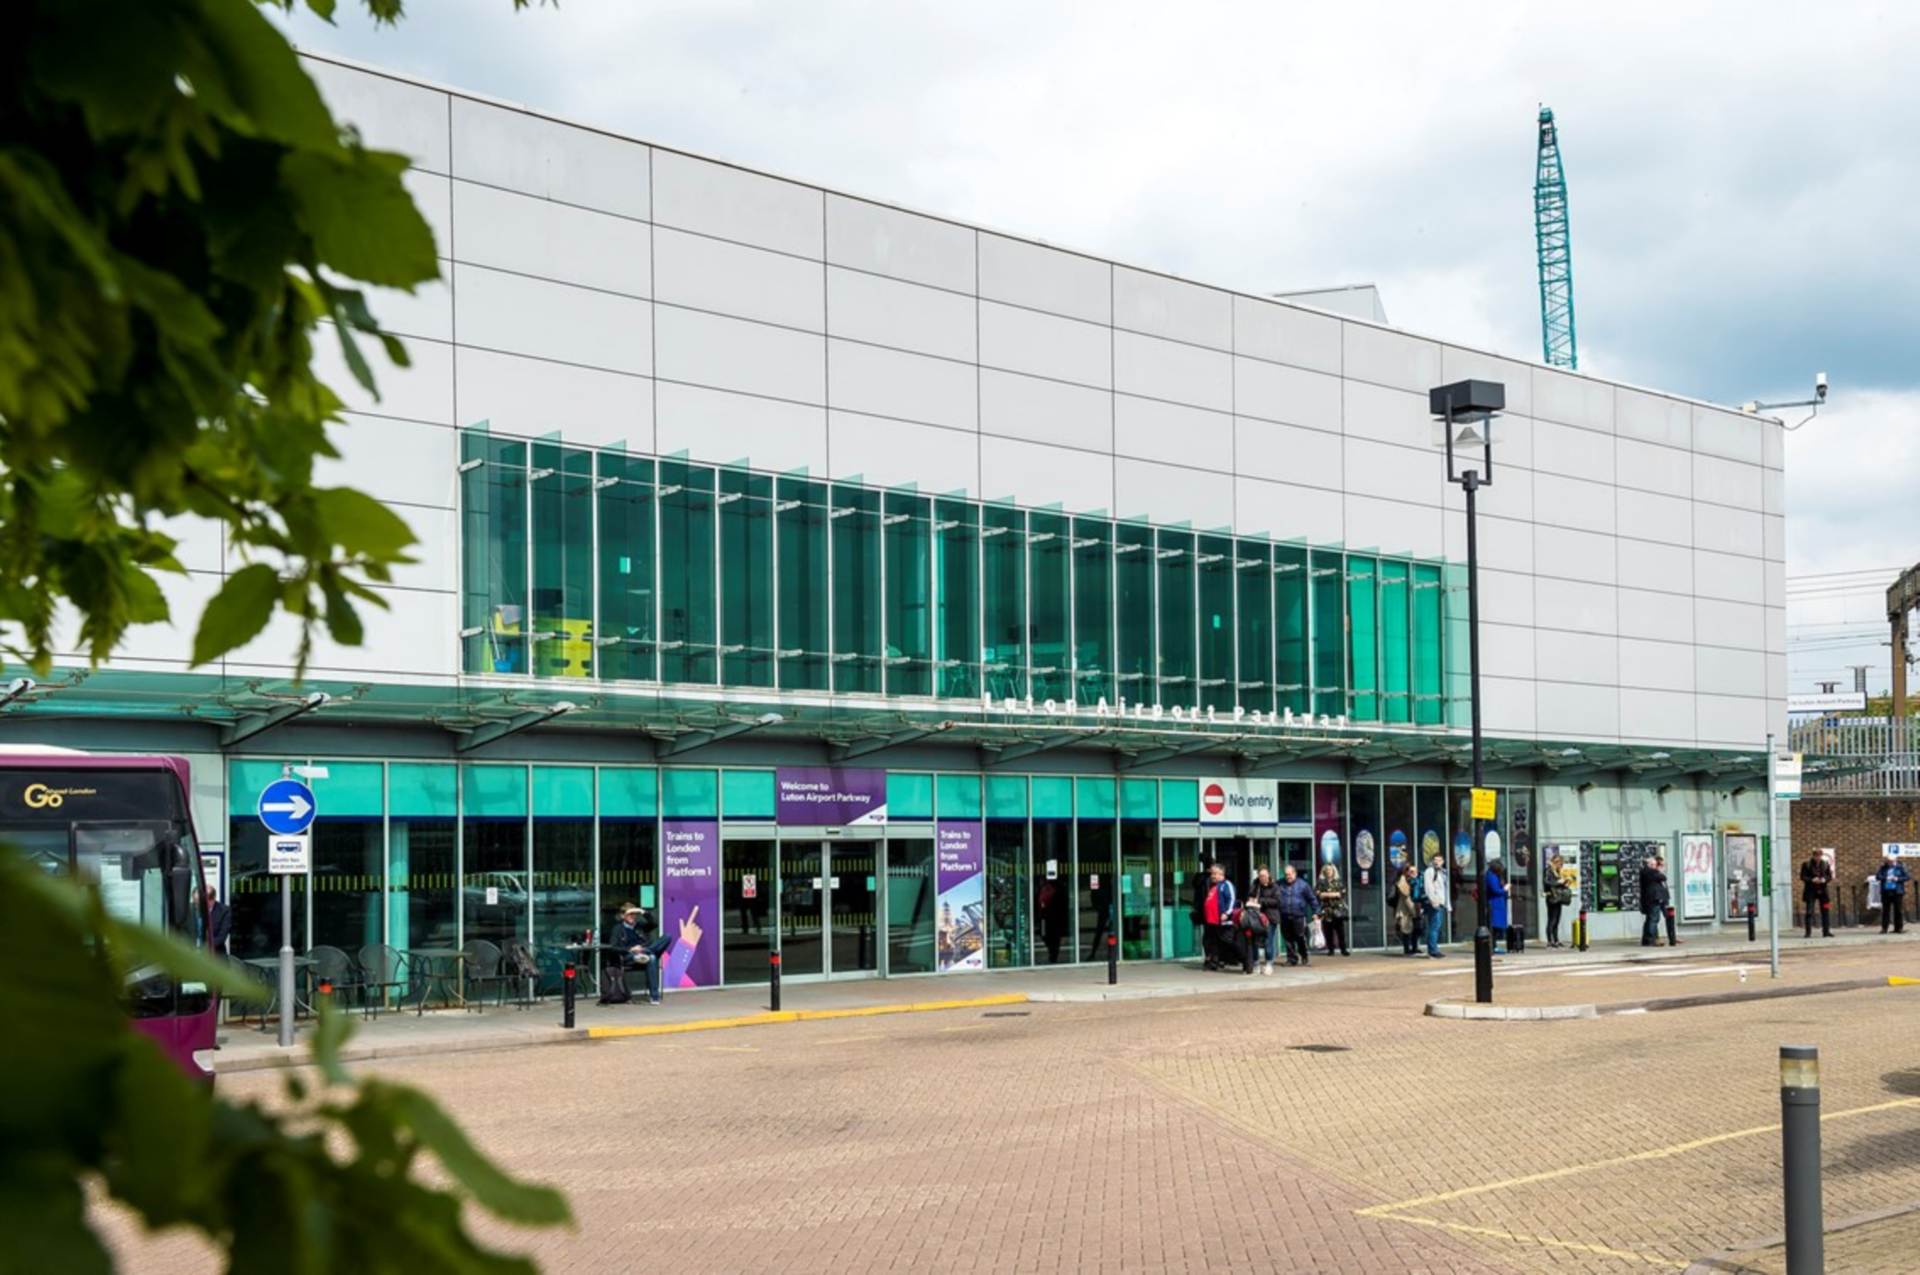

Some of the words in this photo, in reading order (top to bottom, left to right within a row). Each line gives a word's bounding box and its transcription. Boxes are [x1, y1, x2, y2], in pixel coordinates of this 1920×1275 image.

[983, 691, 1077, 714] Luton
[1097, 696, 1215, 723] Airport
[1233, 705, 1346, 730] Parkway
[781, 782, 819, 791] Welcome
[820, 783, 829, 791] to
[24, 783, 63, 808] Go
[781, 793, 805, 801] Luton
[806, 793, 836, 803] Airport
[837, 793, 870, 803] Parkway
[1229, 794, 1245, 807] No
[1247, 795, 1273, 810] entry
[666, 831, 693, 841] Trains
[694, 832, 704, 840] to
[941, 830, 962, 840] Trains
[963, 831, 971, 839] to
[666, 843, 701, 853] London
[941, 841, 968, 850] London
[666, 855, 689, 865] from
[941, 852, 959, 861] from
[941, 862, 972, 871] Platform
[667, 867, 706, 877] Platform
